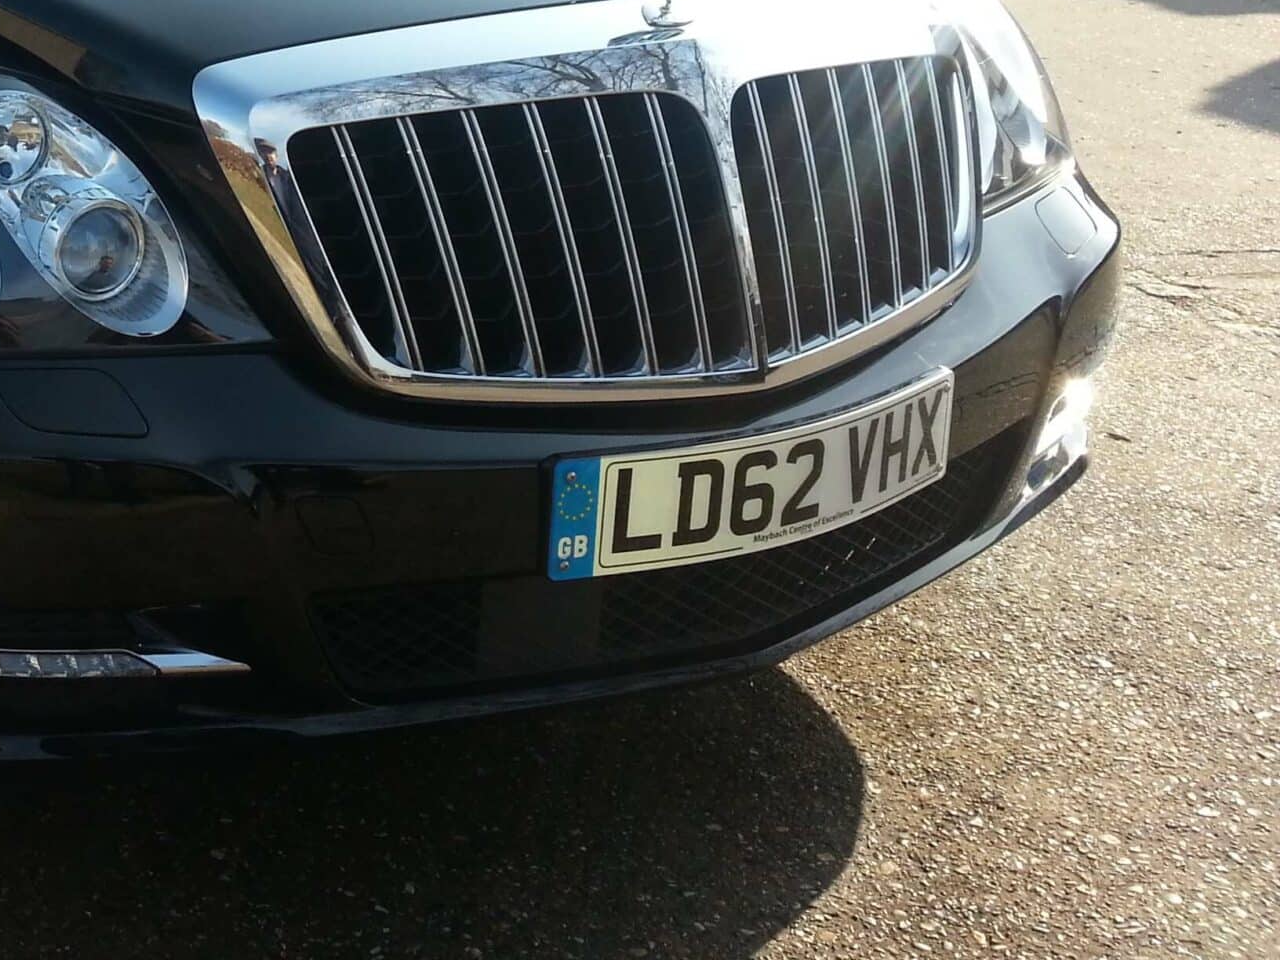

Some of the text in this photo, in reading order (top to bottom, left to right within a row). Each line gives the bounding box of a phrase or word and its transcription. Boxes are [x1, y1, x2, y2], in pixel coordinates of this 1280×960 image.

[611, 389, 942, 555] LD62 VHX
[753, 528, 788, 543] Maybach
[813, 518, 822, 528] of
[557, 534, 588, 559] GB
